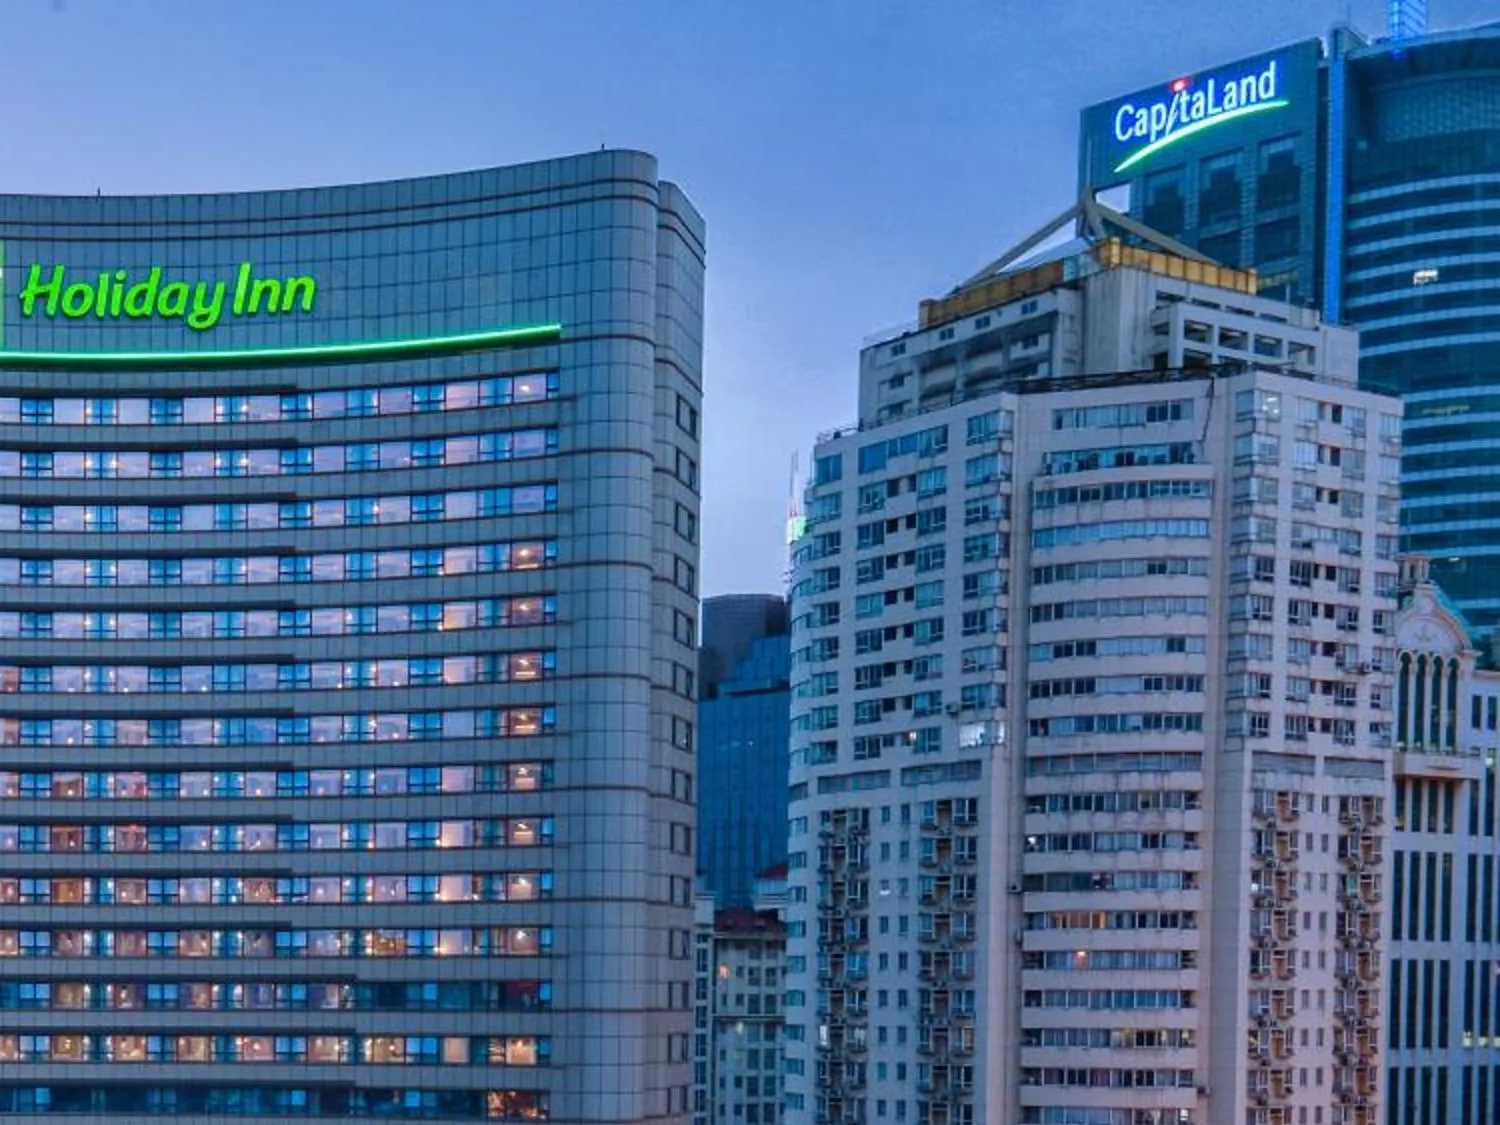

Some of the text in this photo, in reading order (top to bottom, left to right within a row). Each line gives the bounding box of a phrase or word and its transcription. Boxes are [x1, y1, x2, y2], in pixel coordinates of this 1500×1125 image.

[1114, 60, 1277, 142] CapitaLand
[20, 262, 226, 330] Holiday
[232, 261, 316, 315] Inn
